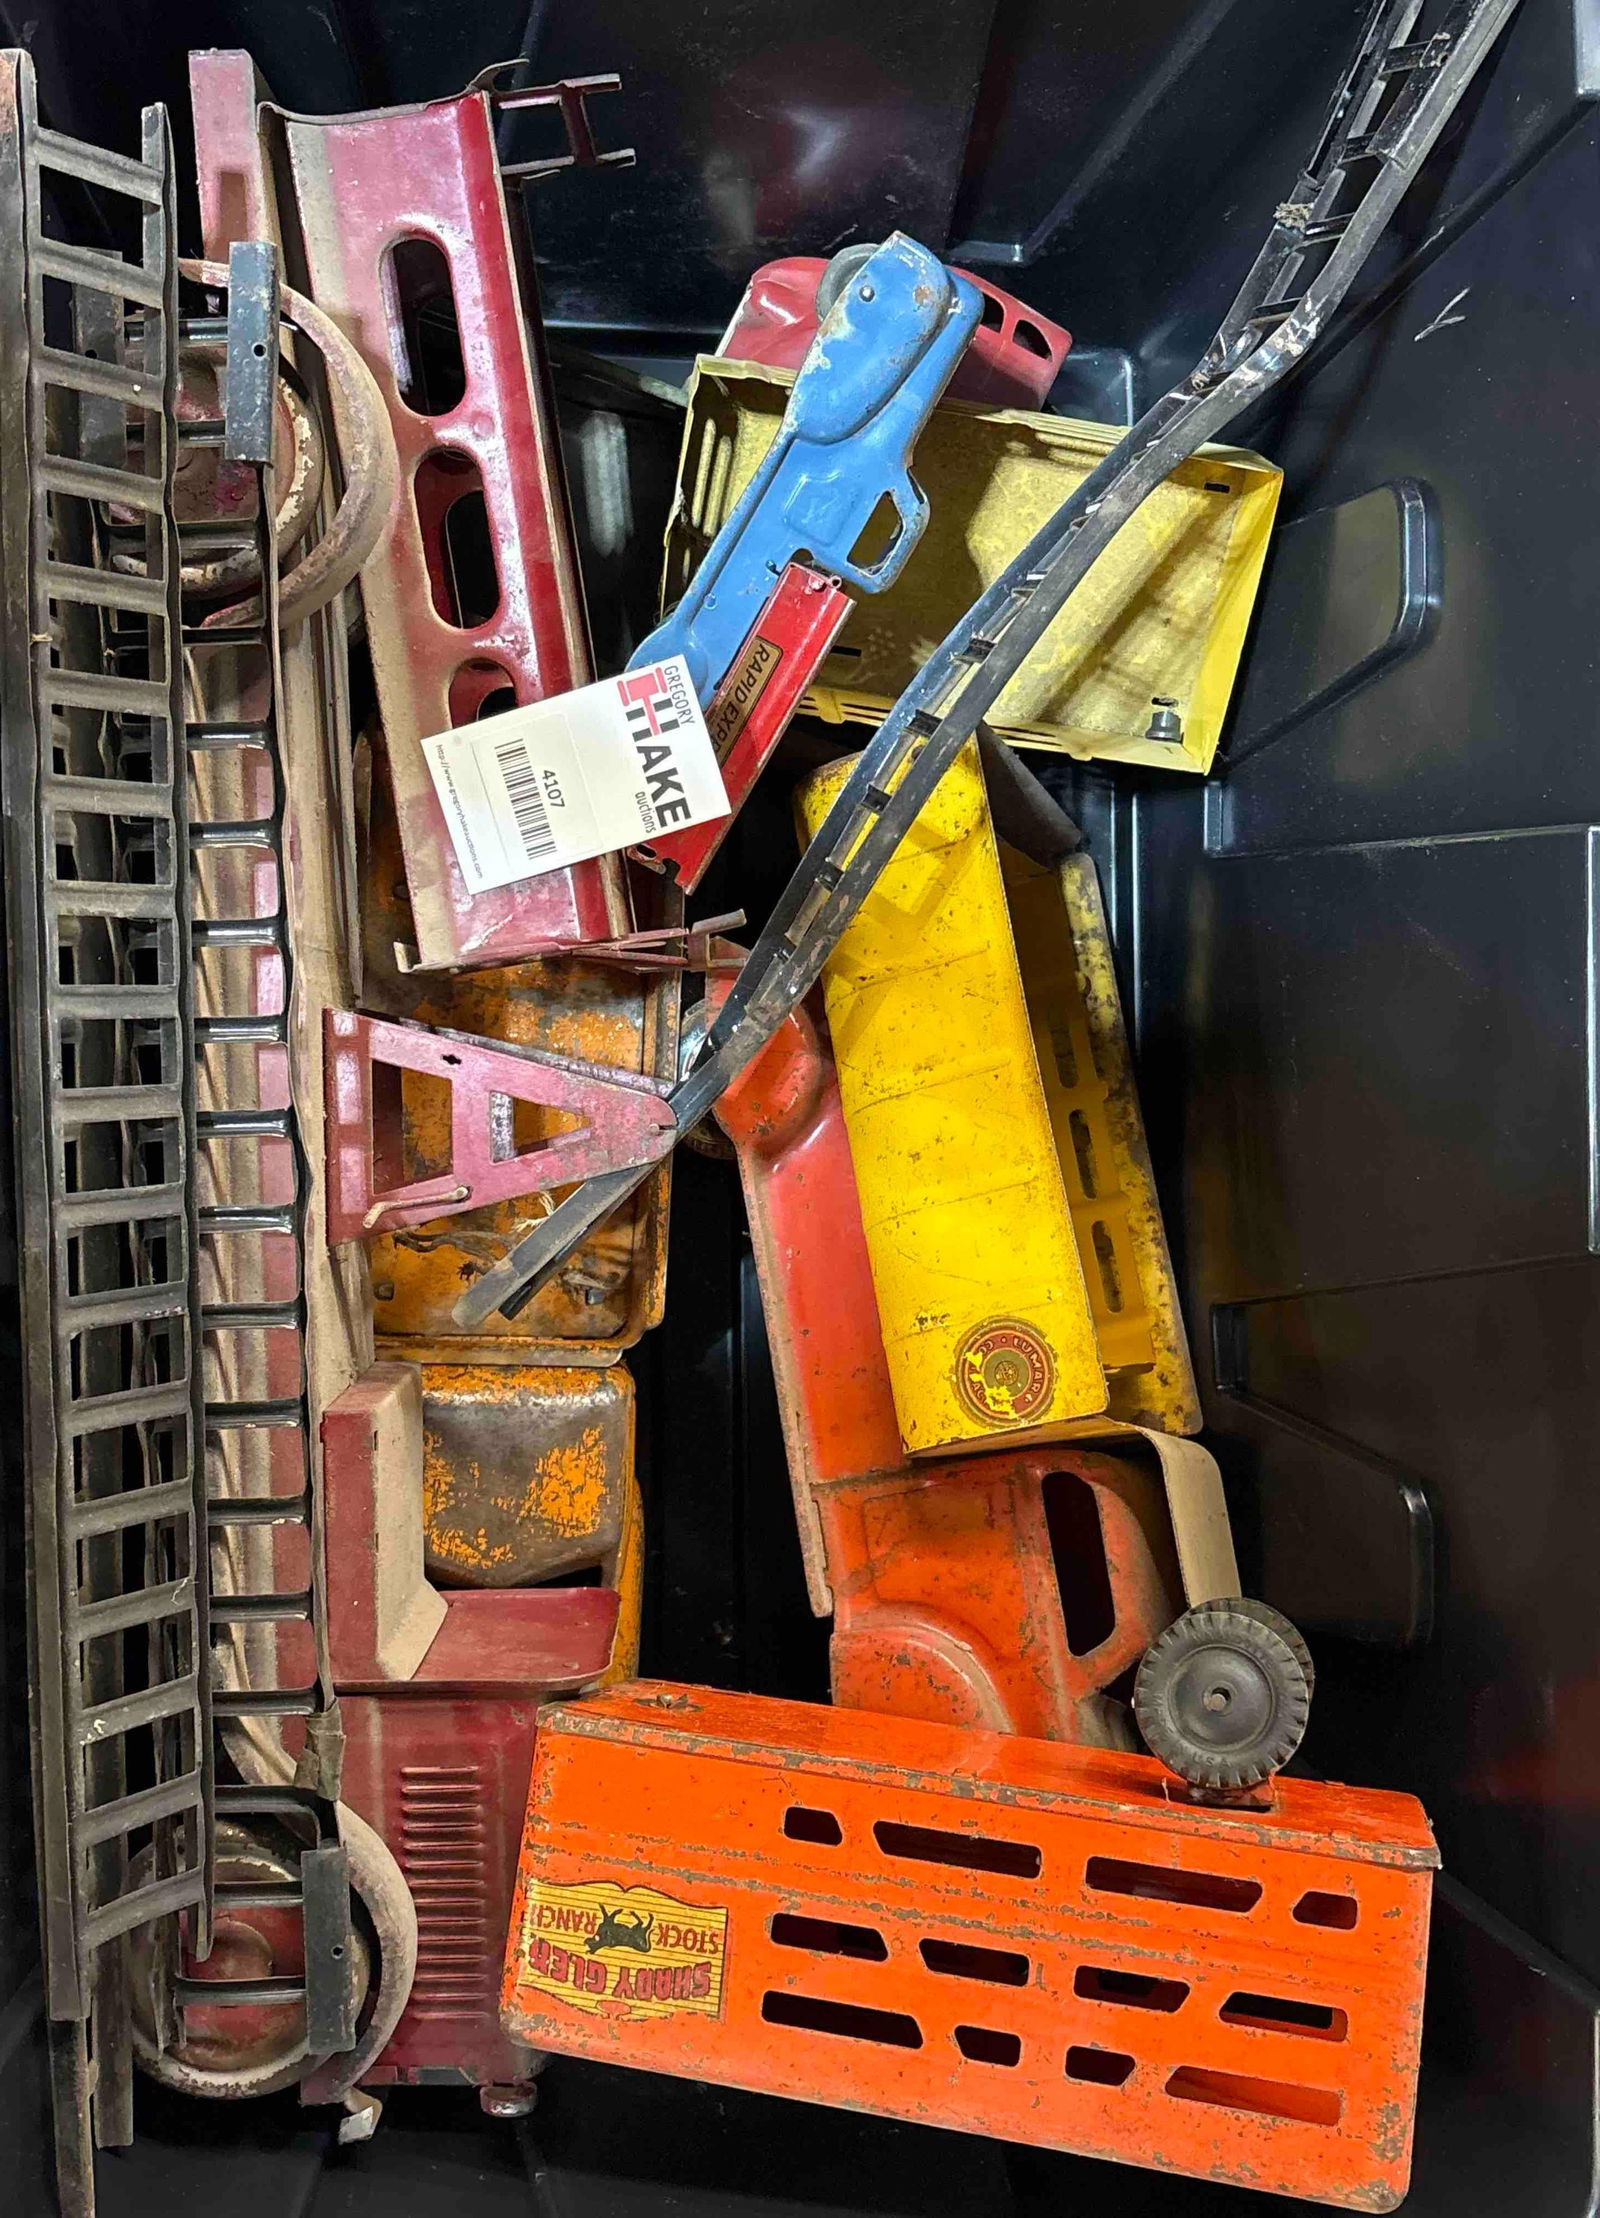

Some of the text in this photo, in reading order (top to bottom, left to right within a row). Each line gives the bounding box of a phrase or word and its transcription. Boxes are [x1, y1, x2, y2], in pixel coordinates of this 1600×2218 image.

[664, 665, 696, 728] GREGORY
[734, 643, 770, 705] RAPID
[543, 769, 566, 809] 4107
[625, 697, 692, 828] HAKE
[436, 744, 483, 879] http://www.gregoryhakeauctions.com
[634, 791, 657, 834] auctions
[1013, 1335, 1043, 1394] LUMAR
[657, 1922, 719, 1954] STOCK
[612, 1961, 712, 2000] SHADY
